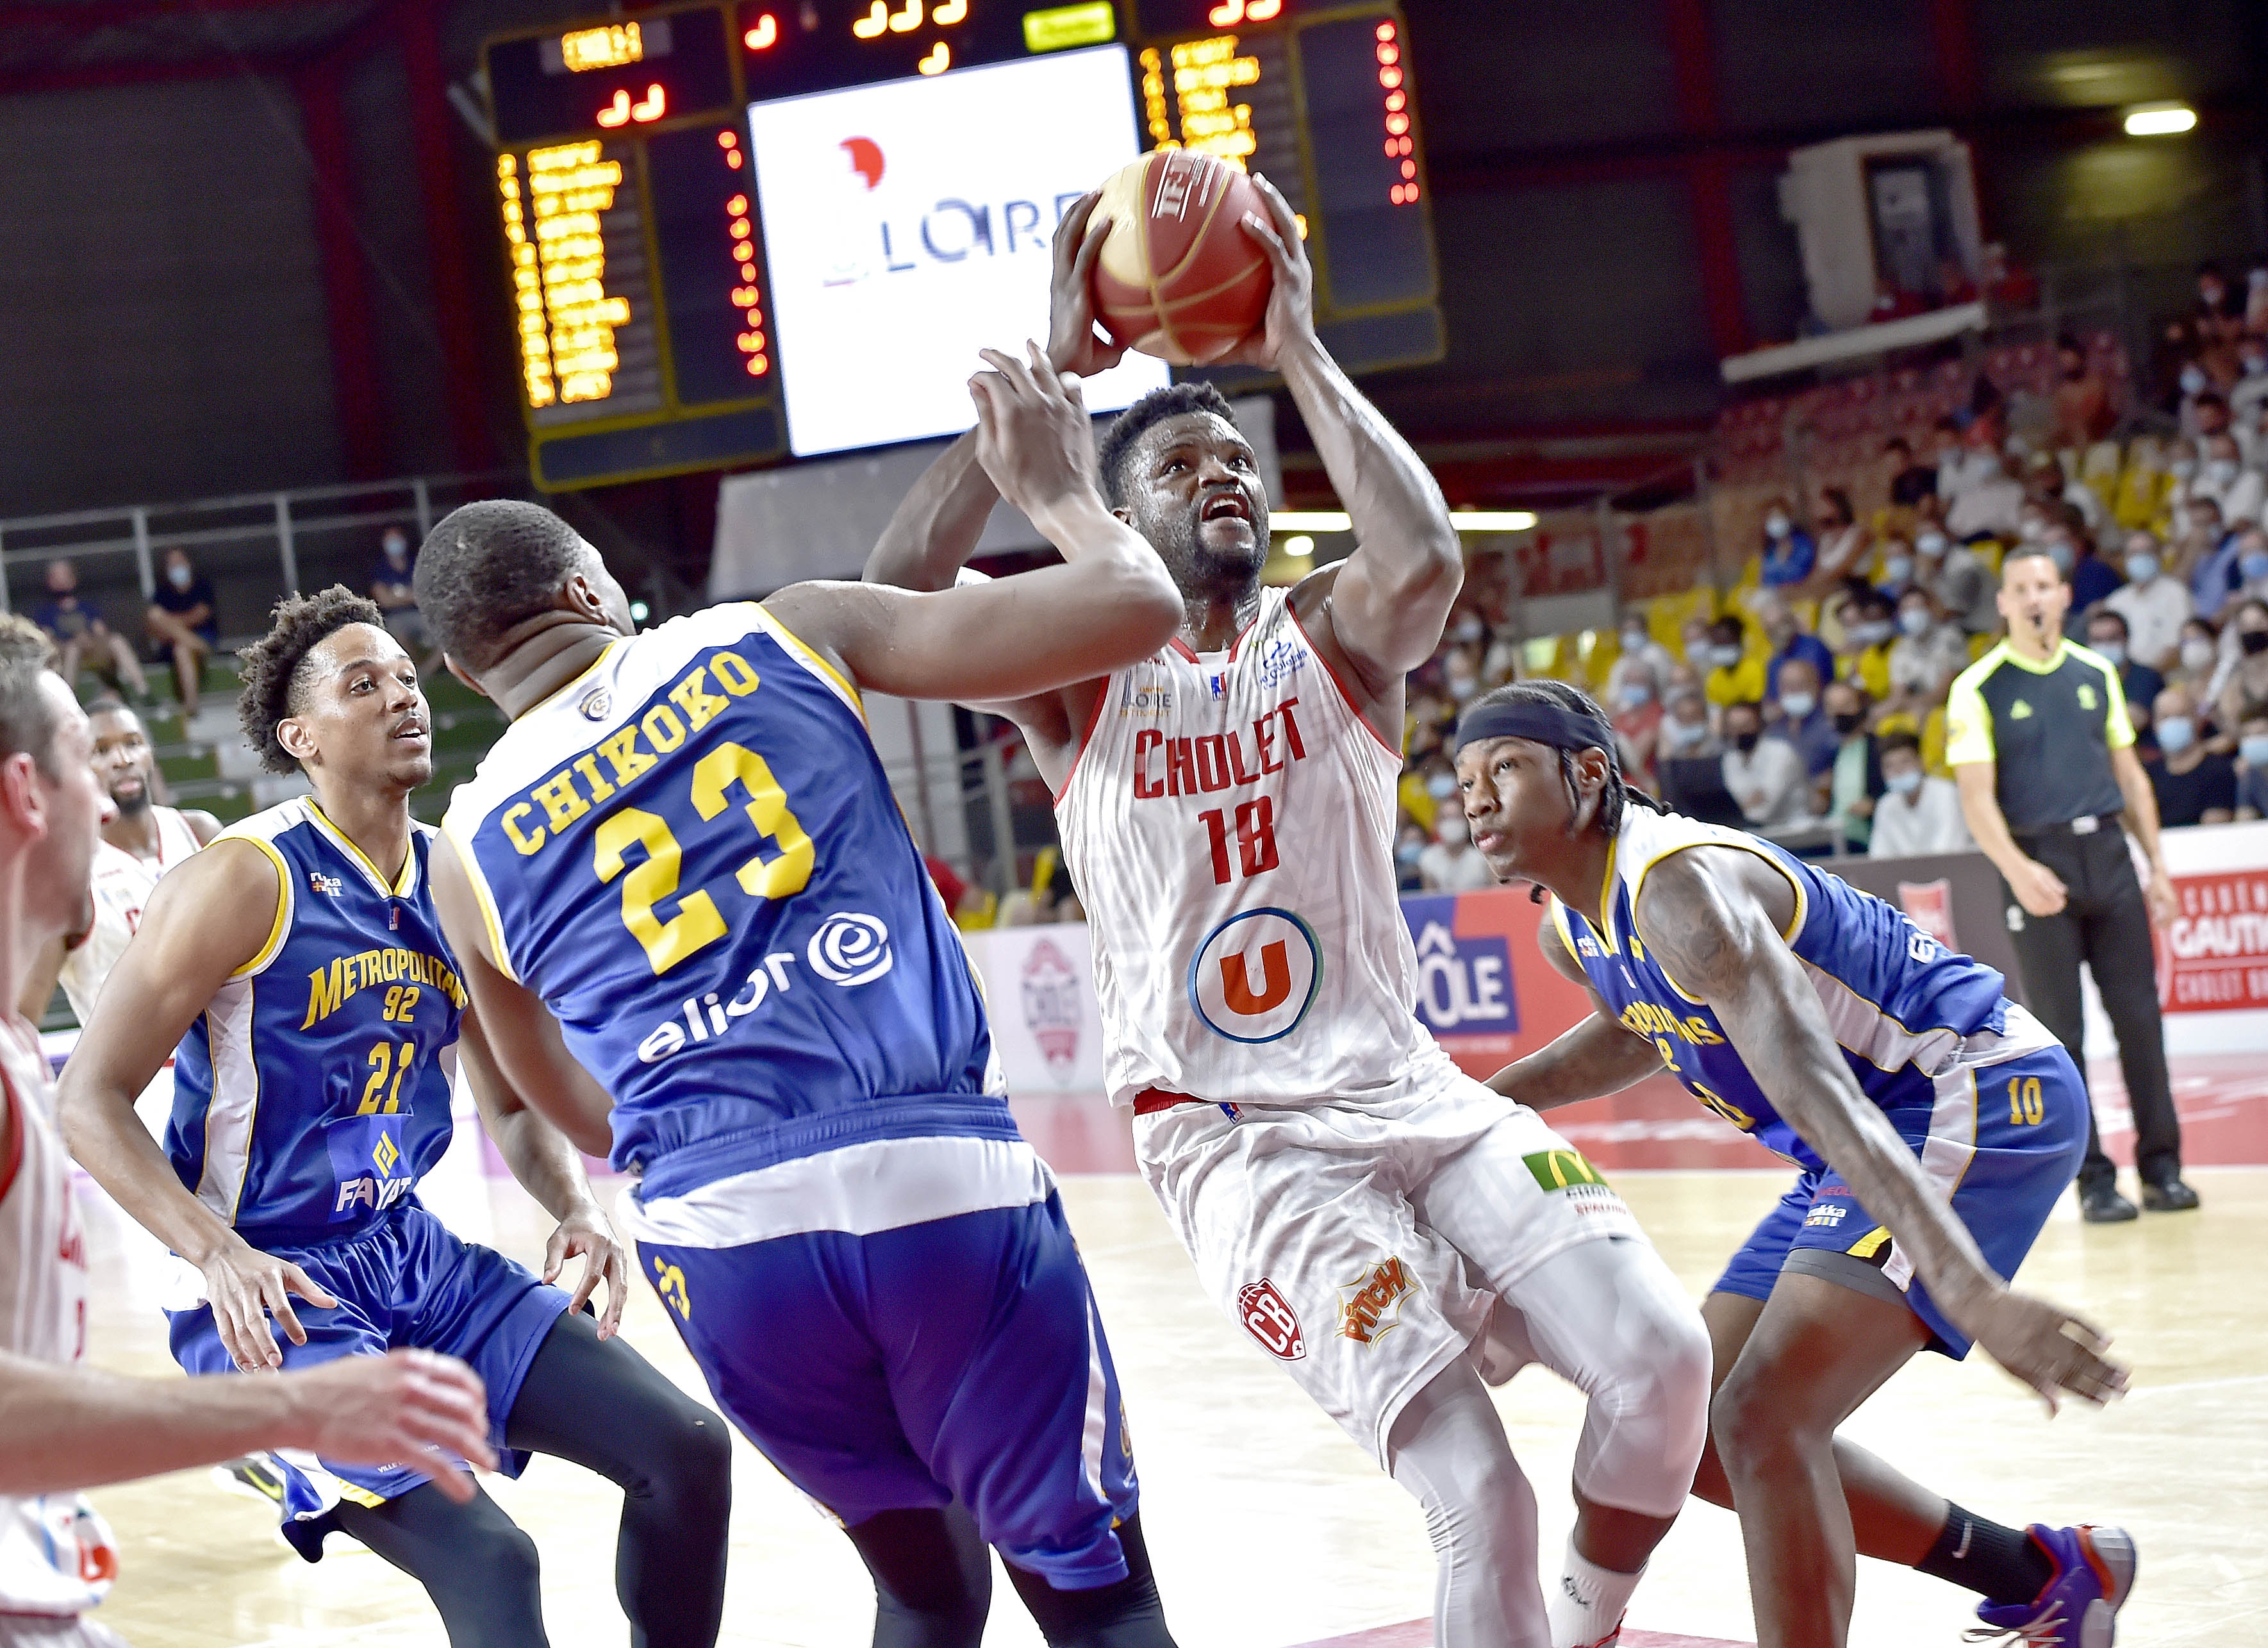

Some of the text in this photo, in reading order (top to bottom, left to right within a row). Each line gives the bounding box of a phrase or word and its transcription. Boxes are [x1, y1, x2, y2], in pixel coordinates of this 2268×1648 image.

[501, 651, 760, 855] CHIKOKO
[1134, 697, 1307, 799] CHOLET
[593, 741, 816, 976] 23
[1198, 795, 1280, 885] 18
[299, 947, 469, 1032] METROPOLITAN
[382, 985, 420, 1023] 92
[637, 951, 796, 1064] elior
[1219, 938, 1292, 1016] U
[1415, 920, 1511, 1029] ÔLE
[356, 1041, 415, 1115] 21
[2007, 1076, 2044, 1126] 10
[335, 1176, 413, 1212] FAYAT
[1248, 1293, 1296, 1354] CB
